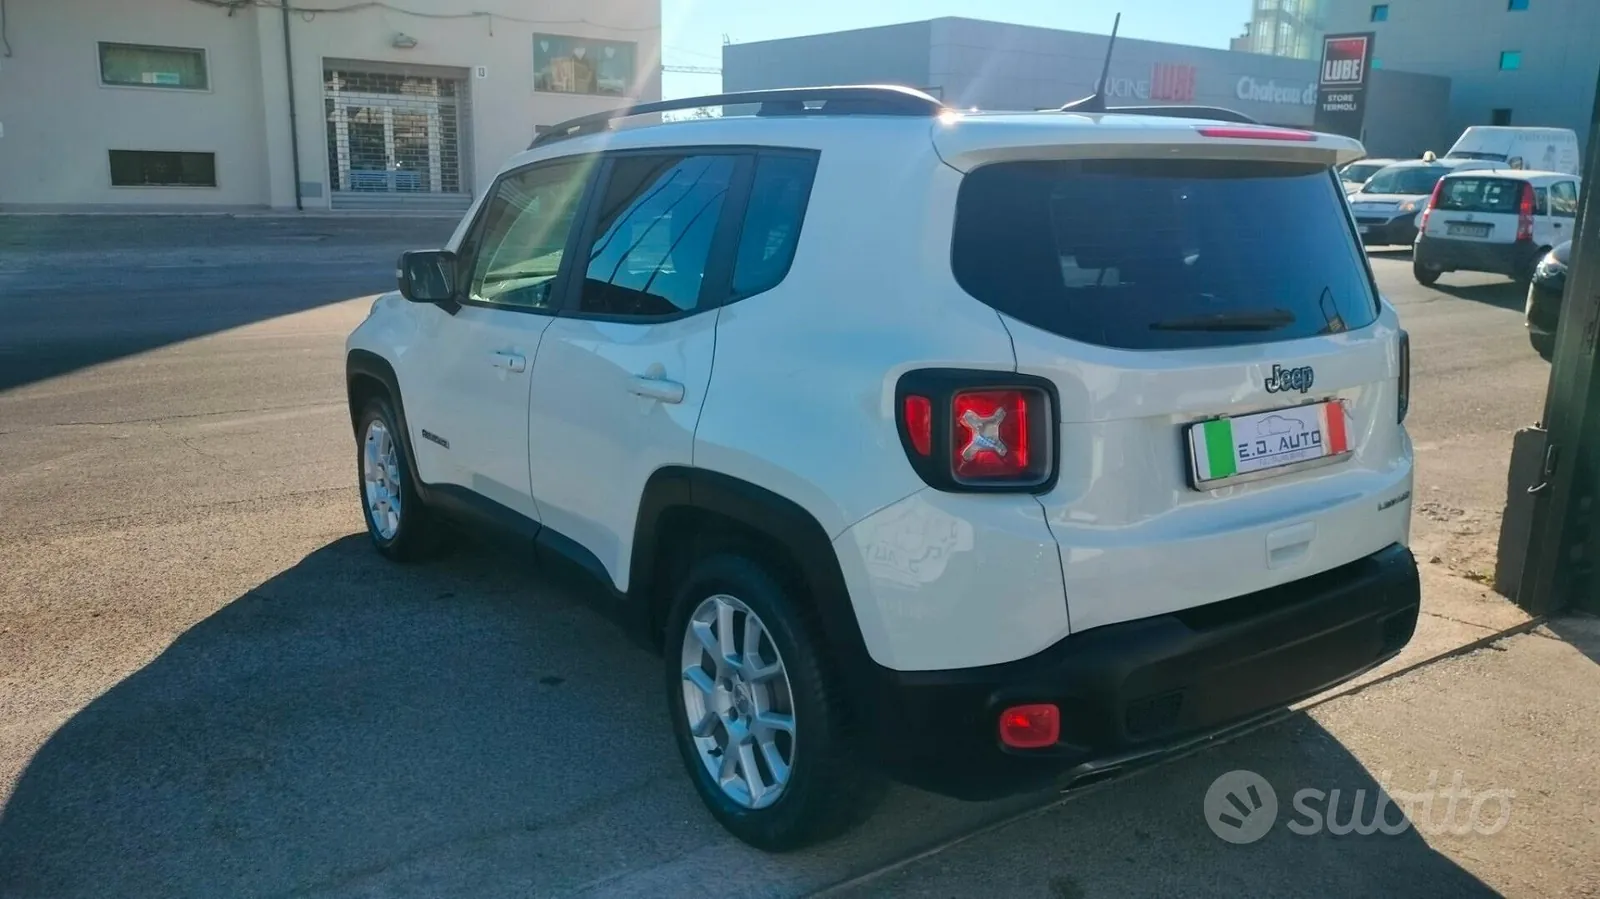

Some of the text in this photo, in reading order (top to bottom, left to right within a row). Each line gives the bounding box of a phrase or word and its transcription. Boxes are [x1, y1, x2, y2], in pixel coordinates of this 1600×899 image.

[1324, 58, 1361, 81] LUBE
[1236, 76, 1301, 104] Chateau
[1327, 93, 1354, 102] STORE
[1322, 102, 1357, 112] TERMOLI
[1265, 364, 1314, 393] Jeep
[1238, 431, 1320, 458] E.D. AUTO
